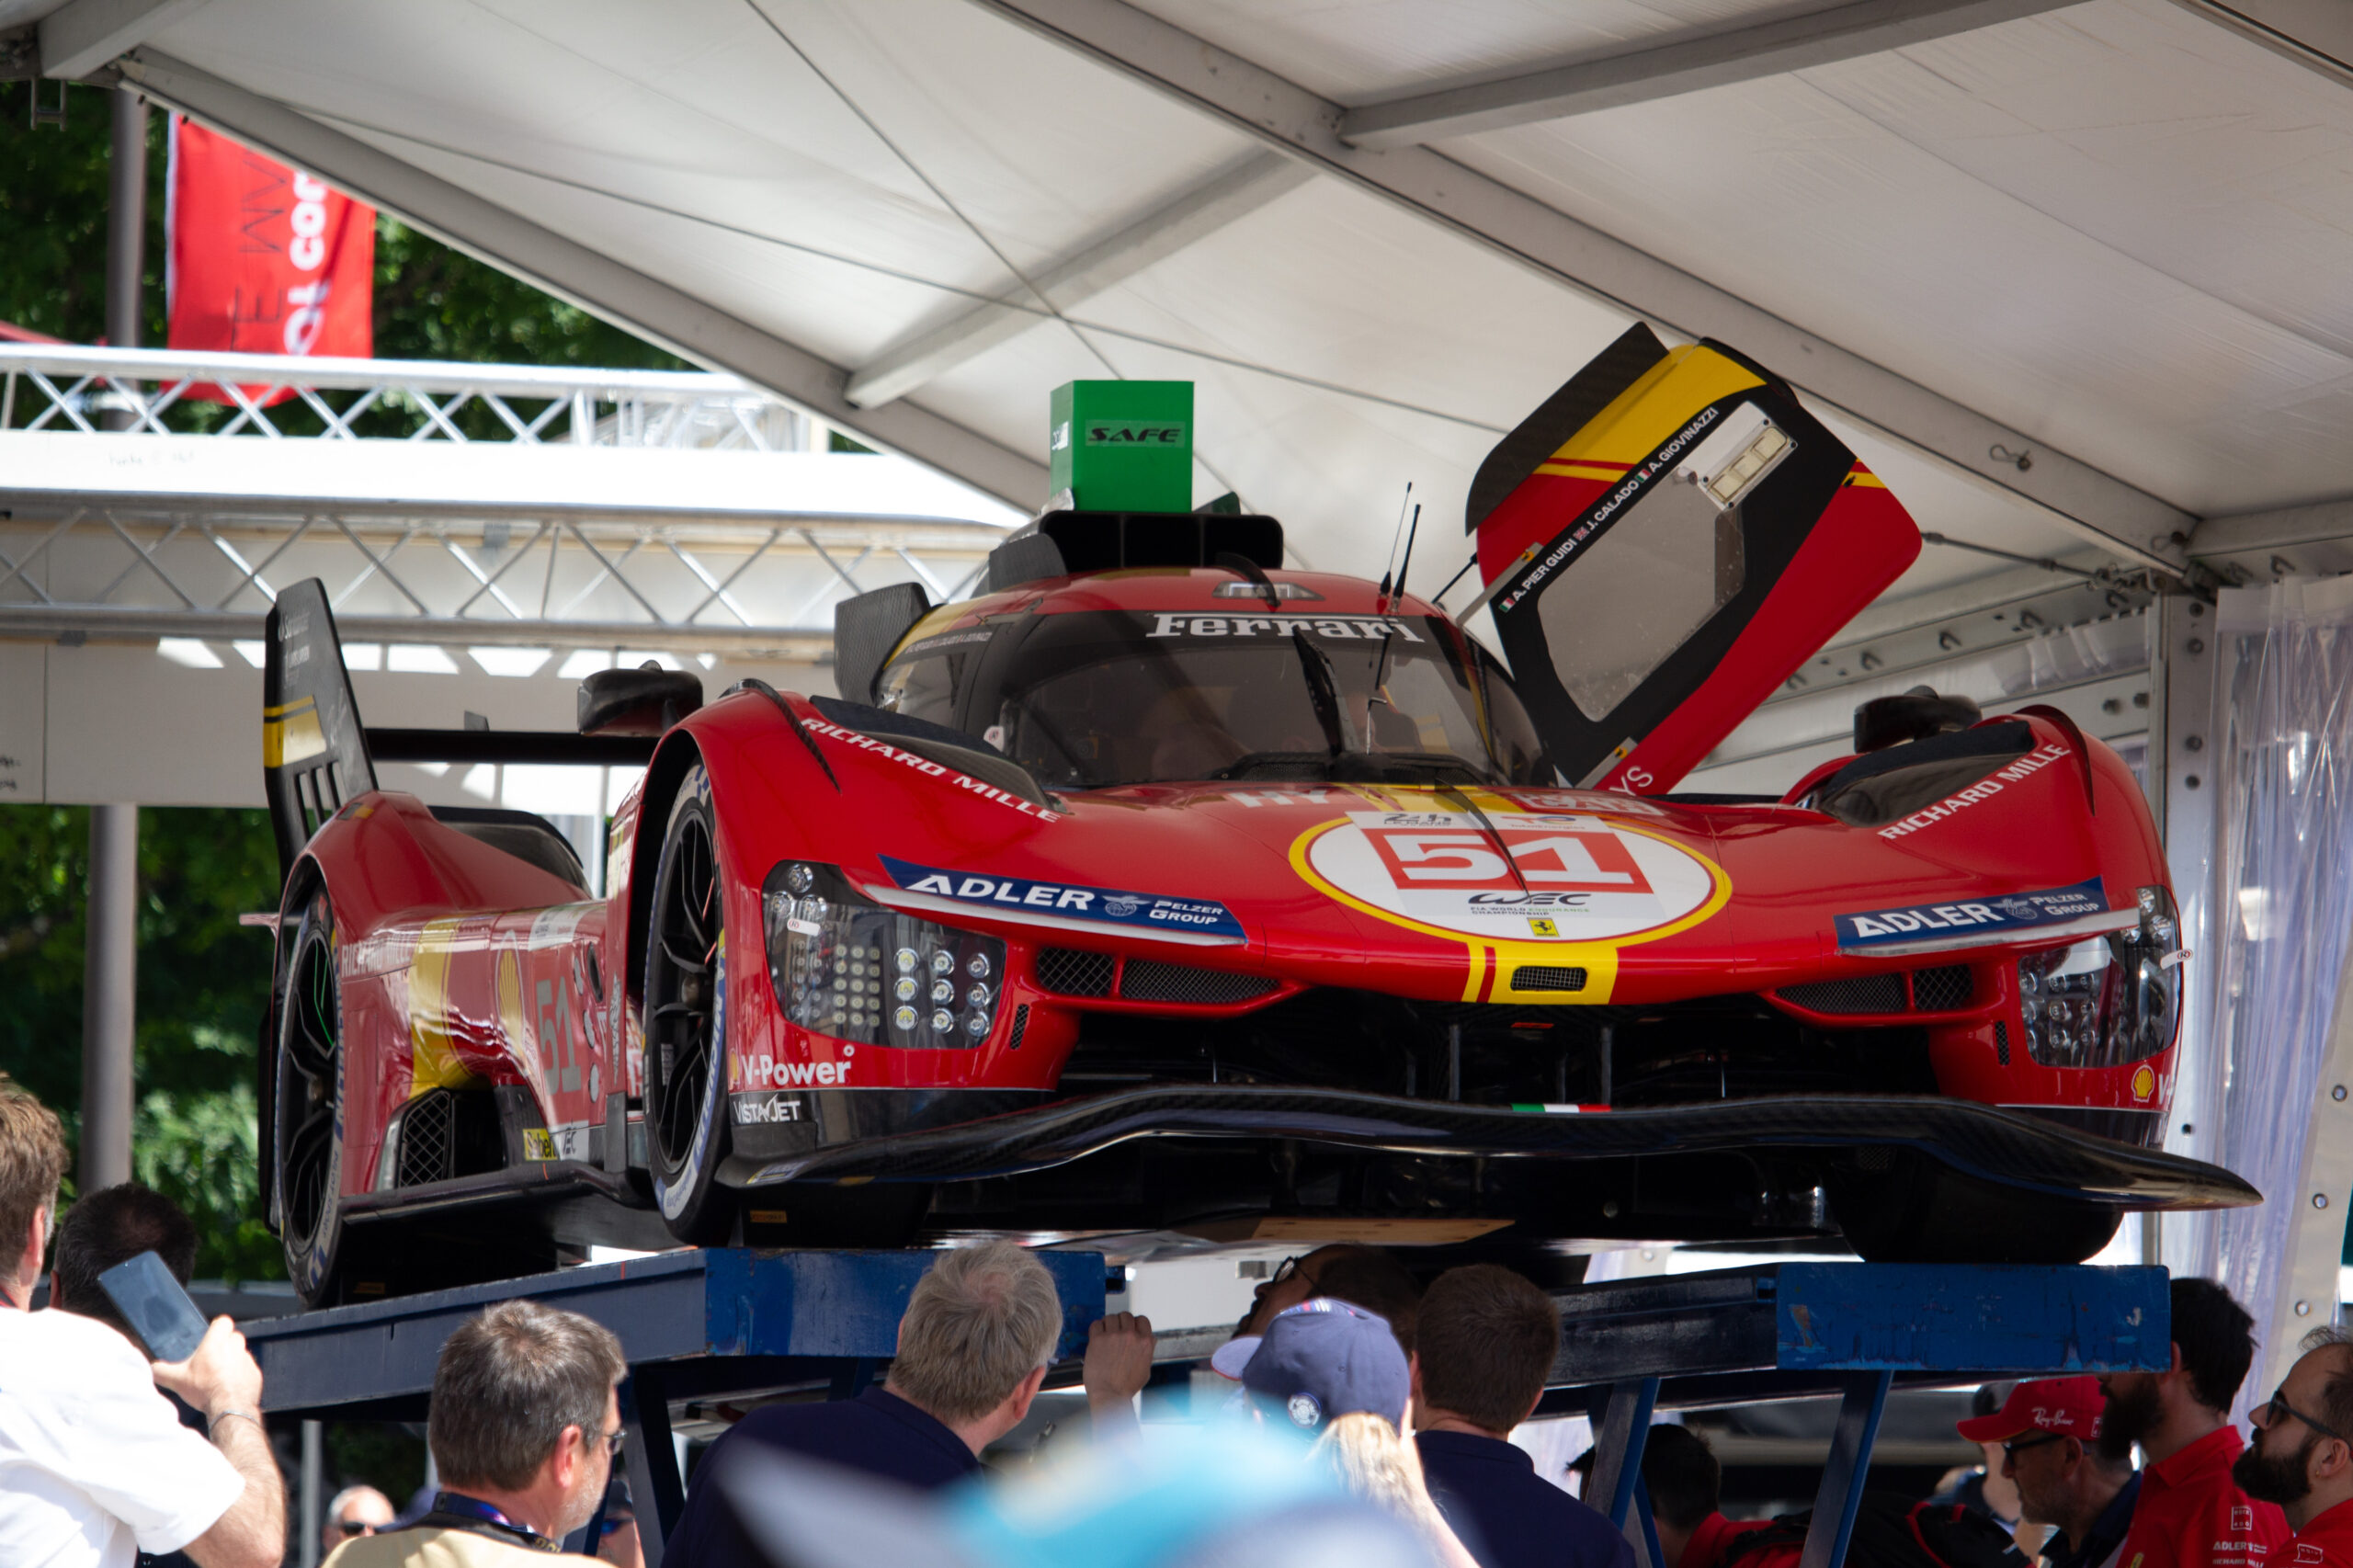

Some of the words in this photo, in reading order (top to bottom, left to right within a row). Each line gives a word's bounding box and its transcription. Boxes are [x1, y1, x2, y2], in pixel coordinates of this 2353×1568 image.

[1088, 427, 1181, 443] SAFE
[1648, 460, 1665, 474] A.
[1658, 407, 1720, 462] GIOVINAZZI
[1586, 518, 1600, 532] J.
[1594, 479, 1640, 523] CALADO
[1512, 589, 1527, 602] A.
[1522, 562, 1552, 590] PIER
[1546, 538, 1578, 568] GUIDI
[1146, 613, 1425, 642] Ferrari
[800, 718, 947, 778] RICHARD
[952, 775, 1061, 824] MILLE
[1877, 778, 2005, 841] RICHARD
[1999, 742, 2072, 783] MILLE
[1382, 834, 1634, 884] 51
[905, 874, 1096, 911] ADLER
[1154, 899, 1224, 915] PELZER
[1468, 892, 1591, 905] WEC
[2029, 893, 2087, 906] PELZER
[2044, 903, 2099, 916] GROUP
[1148, 909, 1219, 926] GROUP
[1849, 903, 2006, 938] ADLER
[536, 975, 582, 1096] 51
[741, 1053, 851, 1086] V-Power
[2212, 1540, 2246, 1551] ADLER
